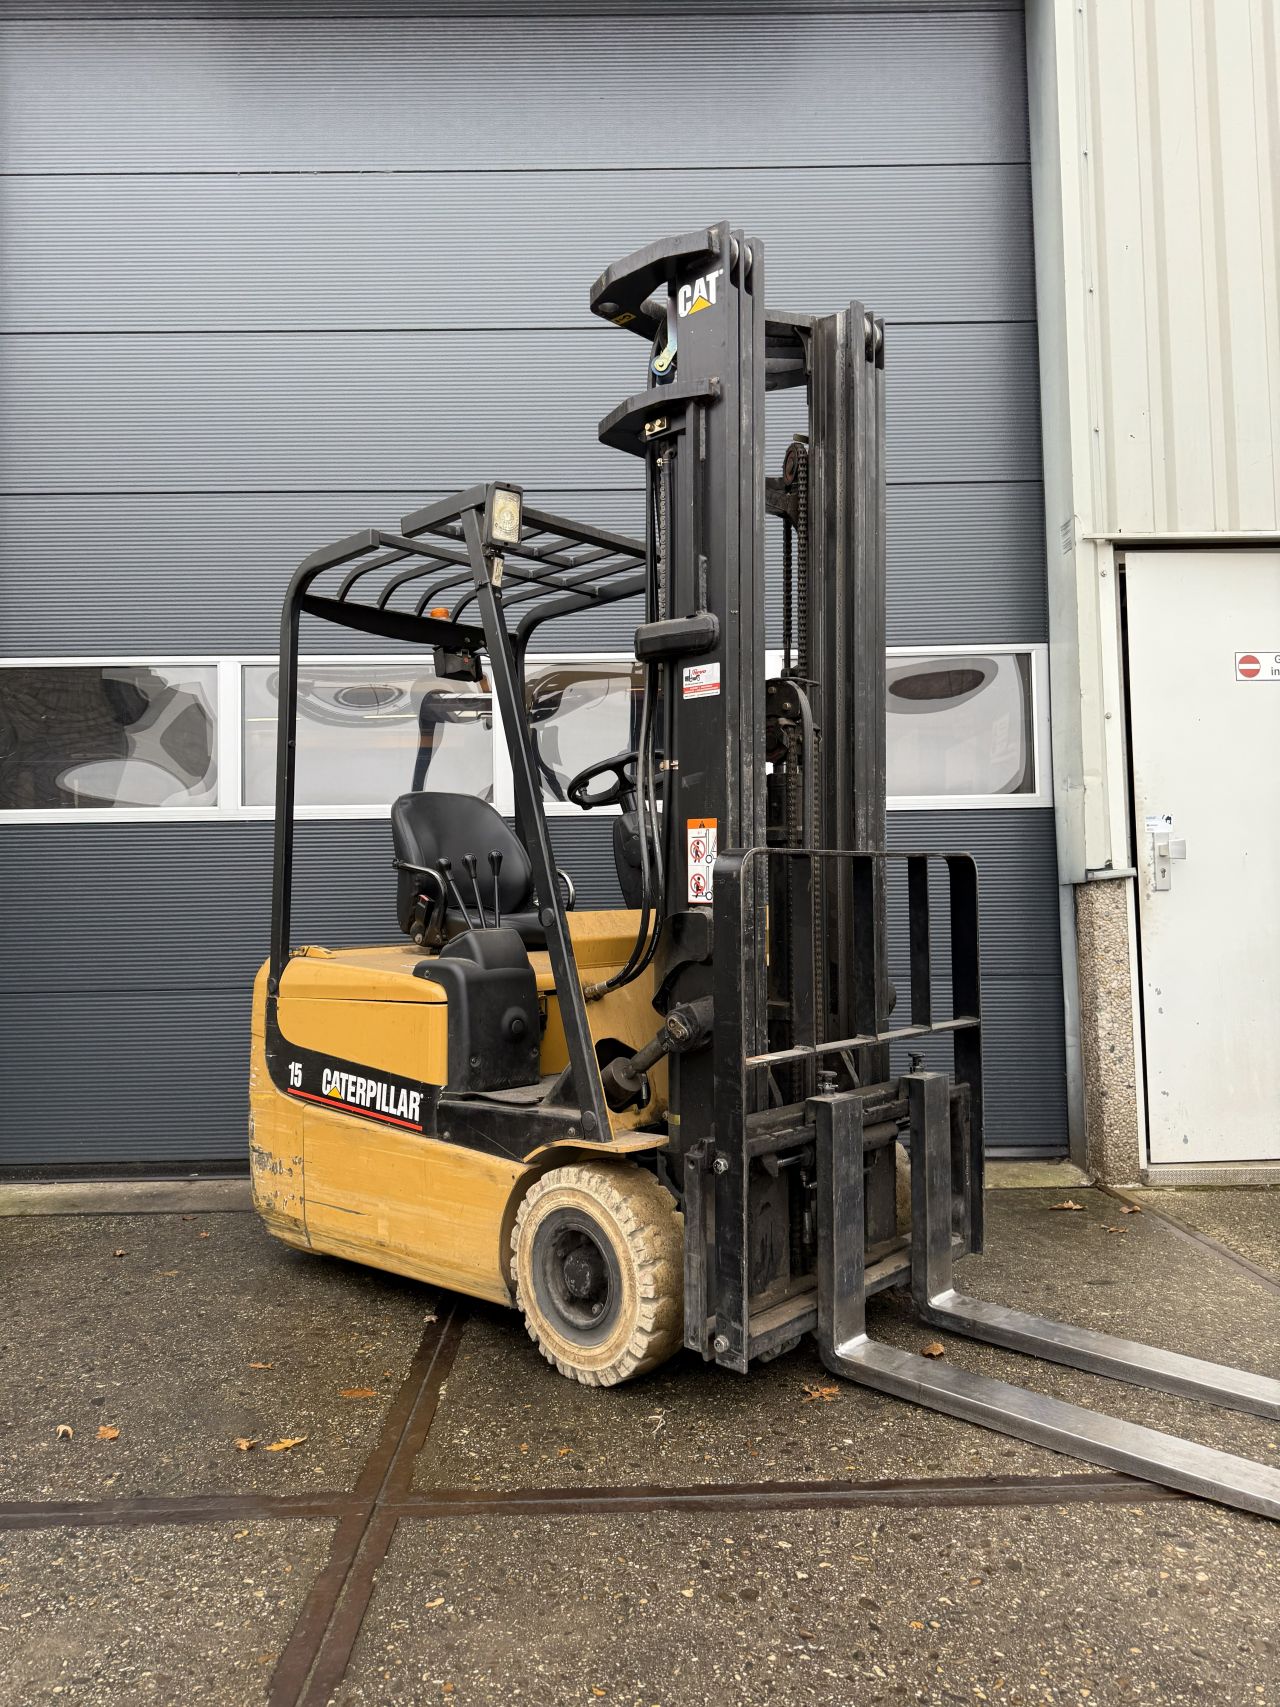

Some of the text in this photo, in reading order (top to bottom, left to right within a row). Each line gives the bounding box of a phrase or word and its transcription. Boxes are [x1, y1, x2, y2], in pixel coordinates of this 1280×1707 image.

[678, 270, 720, 318] CAT
[288, 1061, 422, 1122] 15 CATERPILLAR
